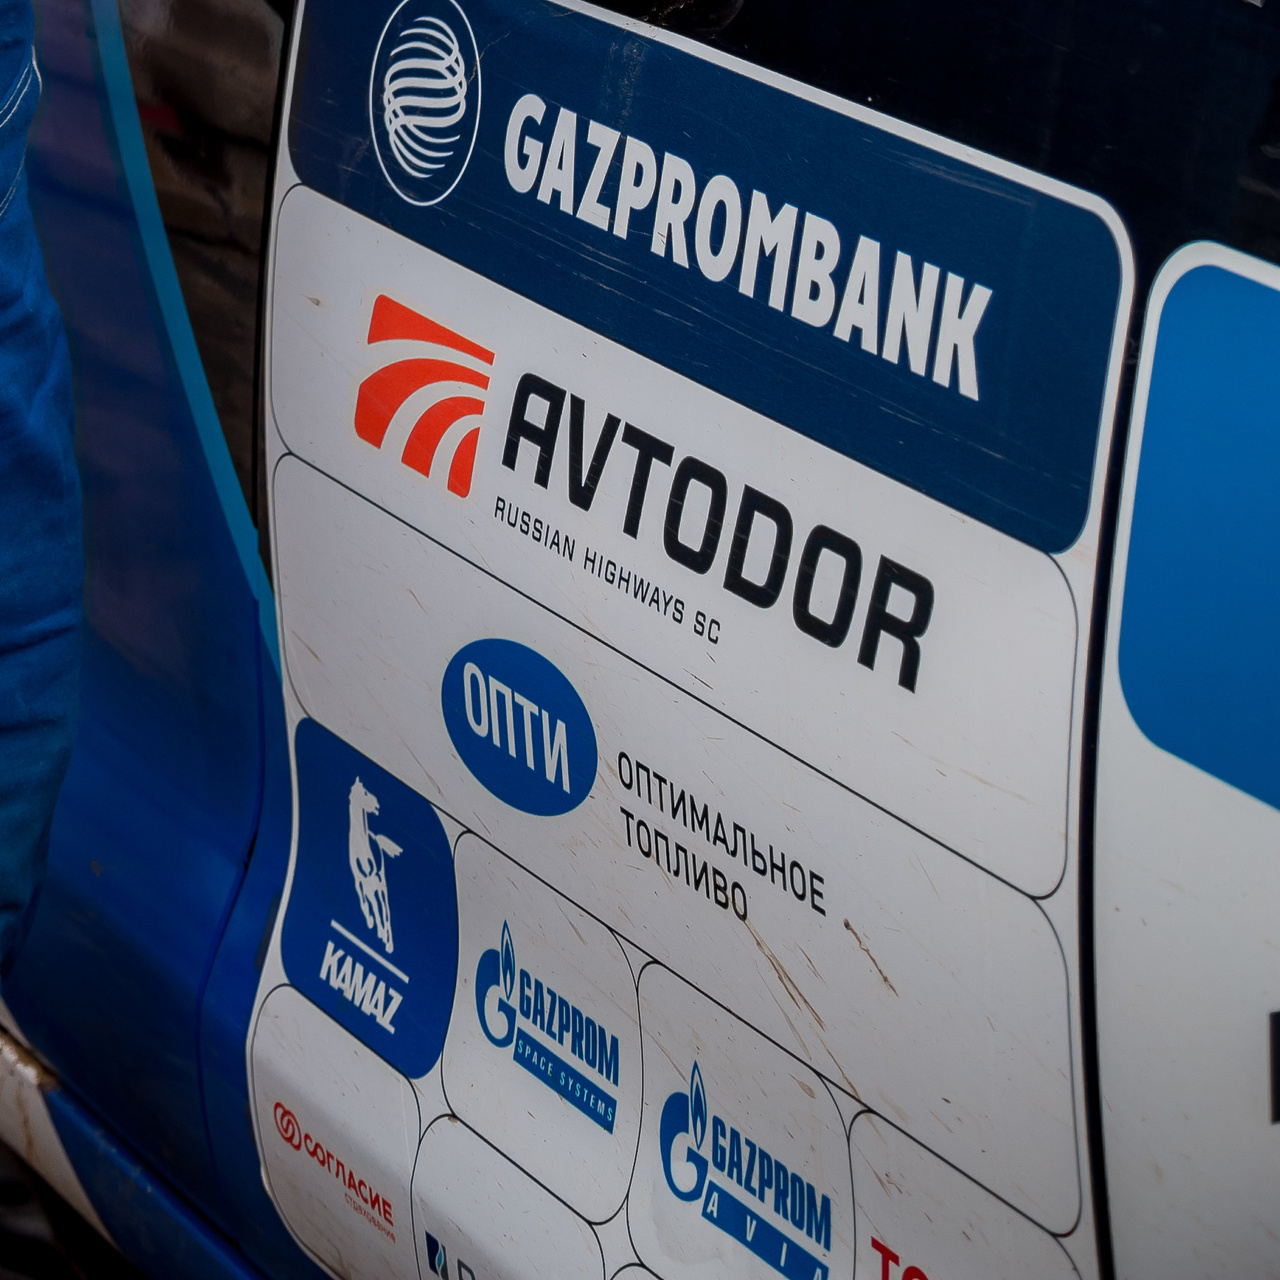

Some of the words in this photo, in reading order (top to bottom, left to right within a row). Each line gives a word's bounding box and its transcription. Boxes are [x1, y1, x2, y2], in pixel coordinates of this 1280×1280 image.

[504, 93, 993, 401] GAZPROMBANK
[494, 495, 576, 562] RUSSIAN
[583, 546, 685, 624] HIGHWAYS
[693, 610, 721, 645] SC
[501, 373, 935, 694] AVTODOR
[463, 662, 570, 794] ОПТИ
[617, 751, 827, 917] ОПТИМАЛЬНОЕ
[619, 806, 748, 922] ТОПЛИВО
[320, 941, 403, 1034] KAMAZ
[519, 968, 619, 1087] GAZPROM
[517, 1038, 554, 1077] SPACE
[559, 1071, 613, 1121] SYSTEMS
[303, 1131, 395, 1228] СОГЛАСИЕ
[711, 1116, 831, 1252] GAZPROM
